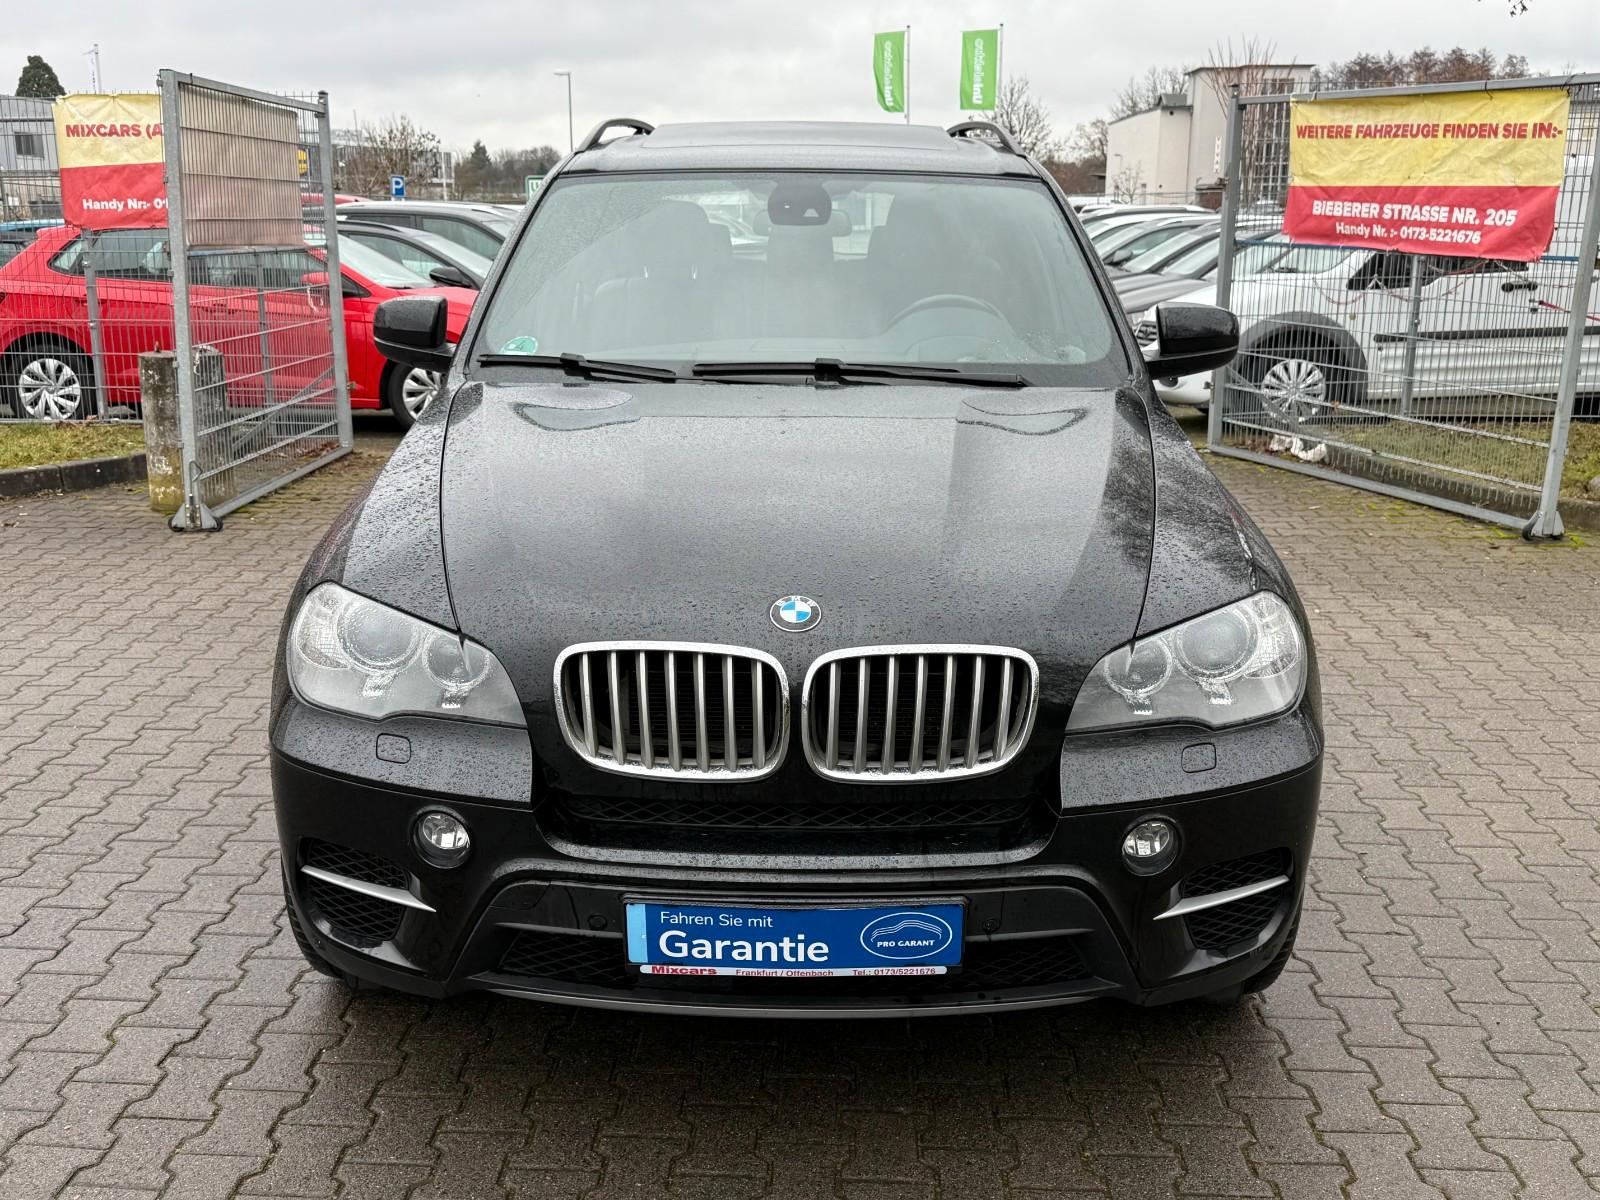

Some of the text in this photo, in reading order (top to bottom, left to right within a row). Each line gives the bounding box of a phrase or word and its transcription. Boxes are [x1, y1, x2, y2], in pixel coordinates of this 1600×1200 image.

[65, 124, 142, 138] MIXCARS
[1296, 125, 1353, 139] WEITERE
[1355, 123, 1440, 139] FAHRZEUGE
[1443, 123, 1499, 139] FINDEN
[1502, 122, 1528, 139] SIE
[392, 178, 404, 197] P
[82, 198, 124, 212] Handy
[1312, 200, 1518, 227] BIEBERER STRASSE NR. 205
[1335, 222, 1370, 239] Handy
[1372, 224, 1388, 238] Nr.
[1399, 225, 1481, 245] 0173-5221676
[660, 911, 773, 928] Fahren Sie mit
[658, 930, 829, 962] Garantie
[877, 939, 936, 948] PRO GARANT
[651, 965, 717, 976] Mixcars
[735, 969, 779, 977] Frankfurt
[786, 969, 834, 977] Offenbach
[874, 967, 936, 976] 0173/5221676
